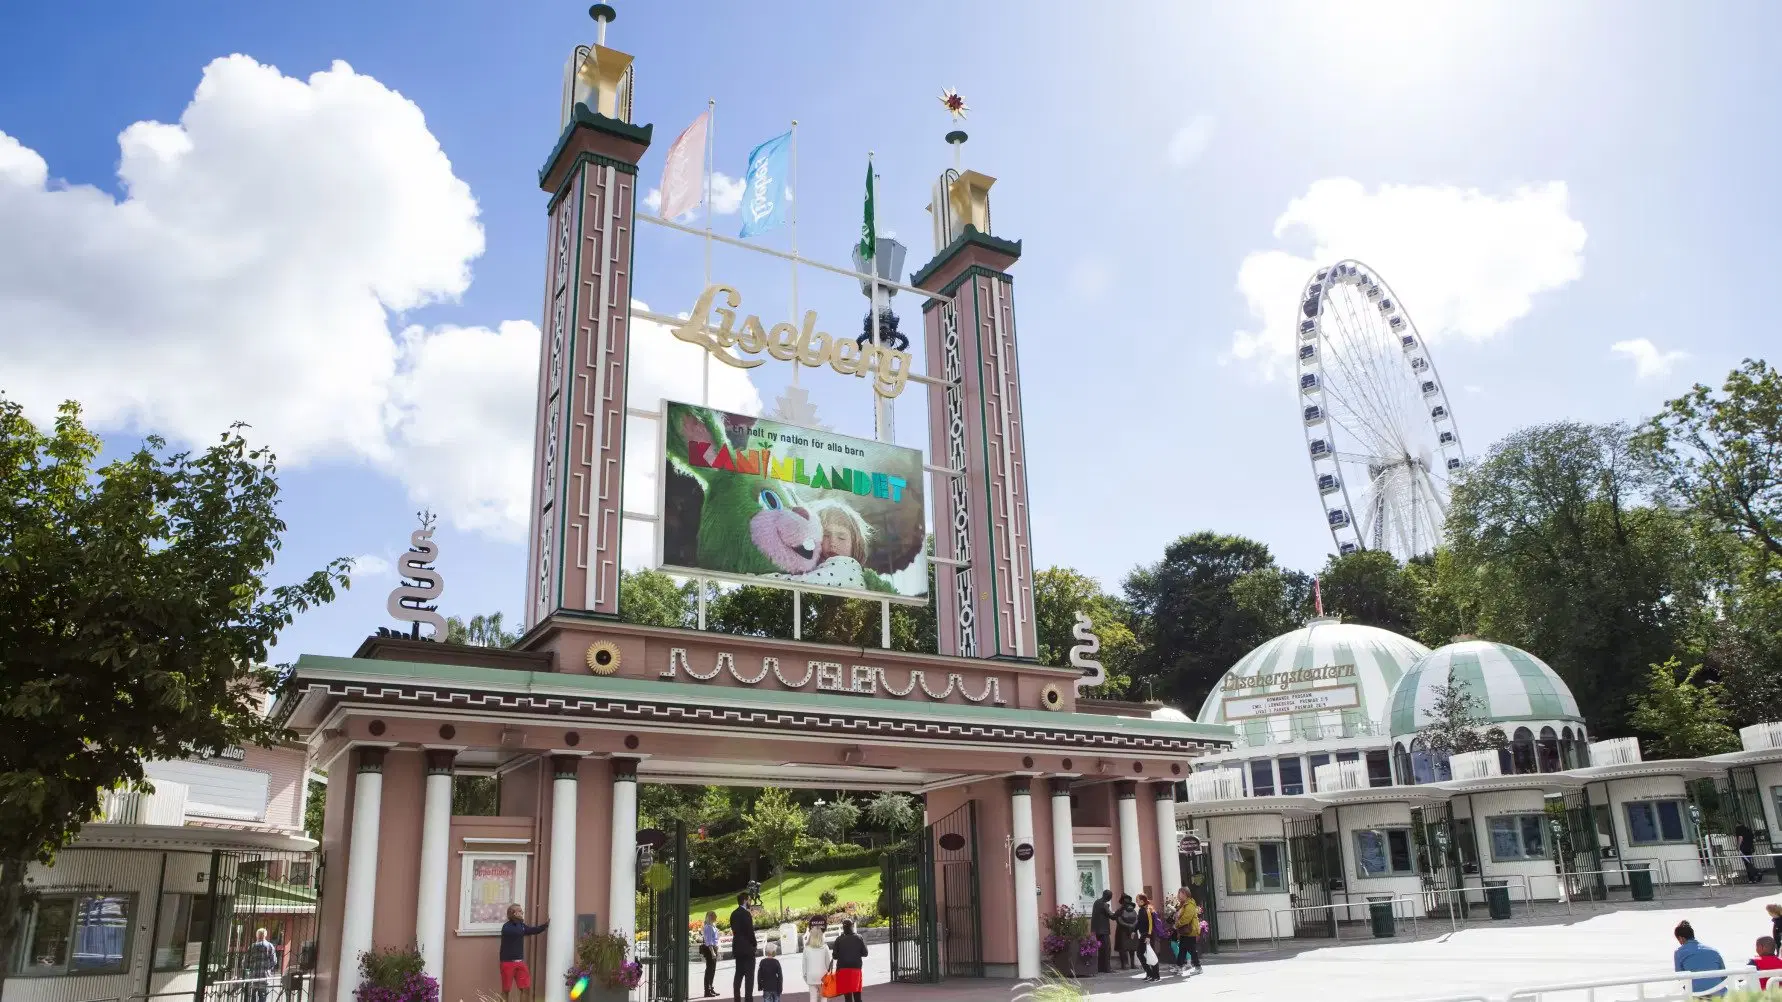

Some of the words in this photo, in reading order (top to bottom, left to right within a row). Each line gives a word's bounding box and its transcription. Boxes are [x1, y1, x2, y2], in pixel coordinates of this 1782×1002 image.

[671, 284, 912, 398] Liseberg
[747, 427, 764, 438] helt
[768, 432, 777, 442] ny
[781, 434, 808, 447] nation
[812, 438, 824, 449] för
[827, 443, 842, 453] alla
[845, 444, 865, 457] barn
[688, 440, 907, 503] KANINLANDET
[1220, 664, 1356, 692] Lisebergsteatern
